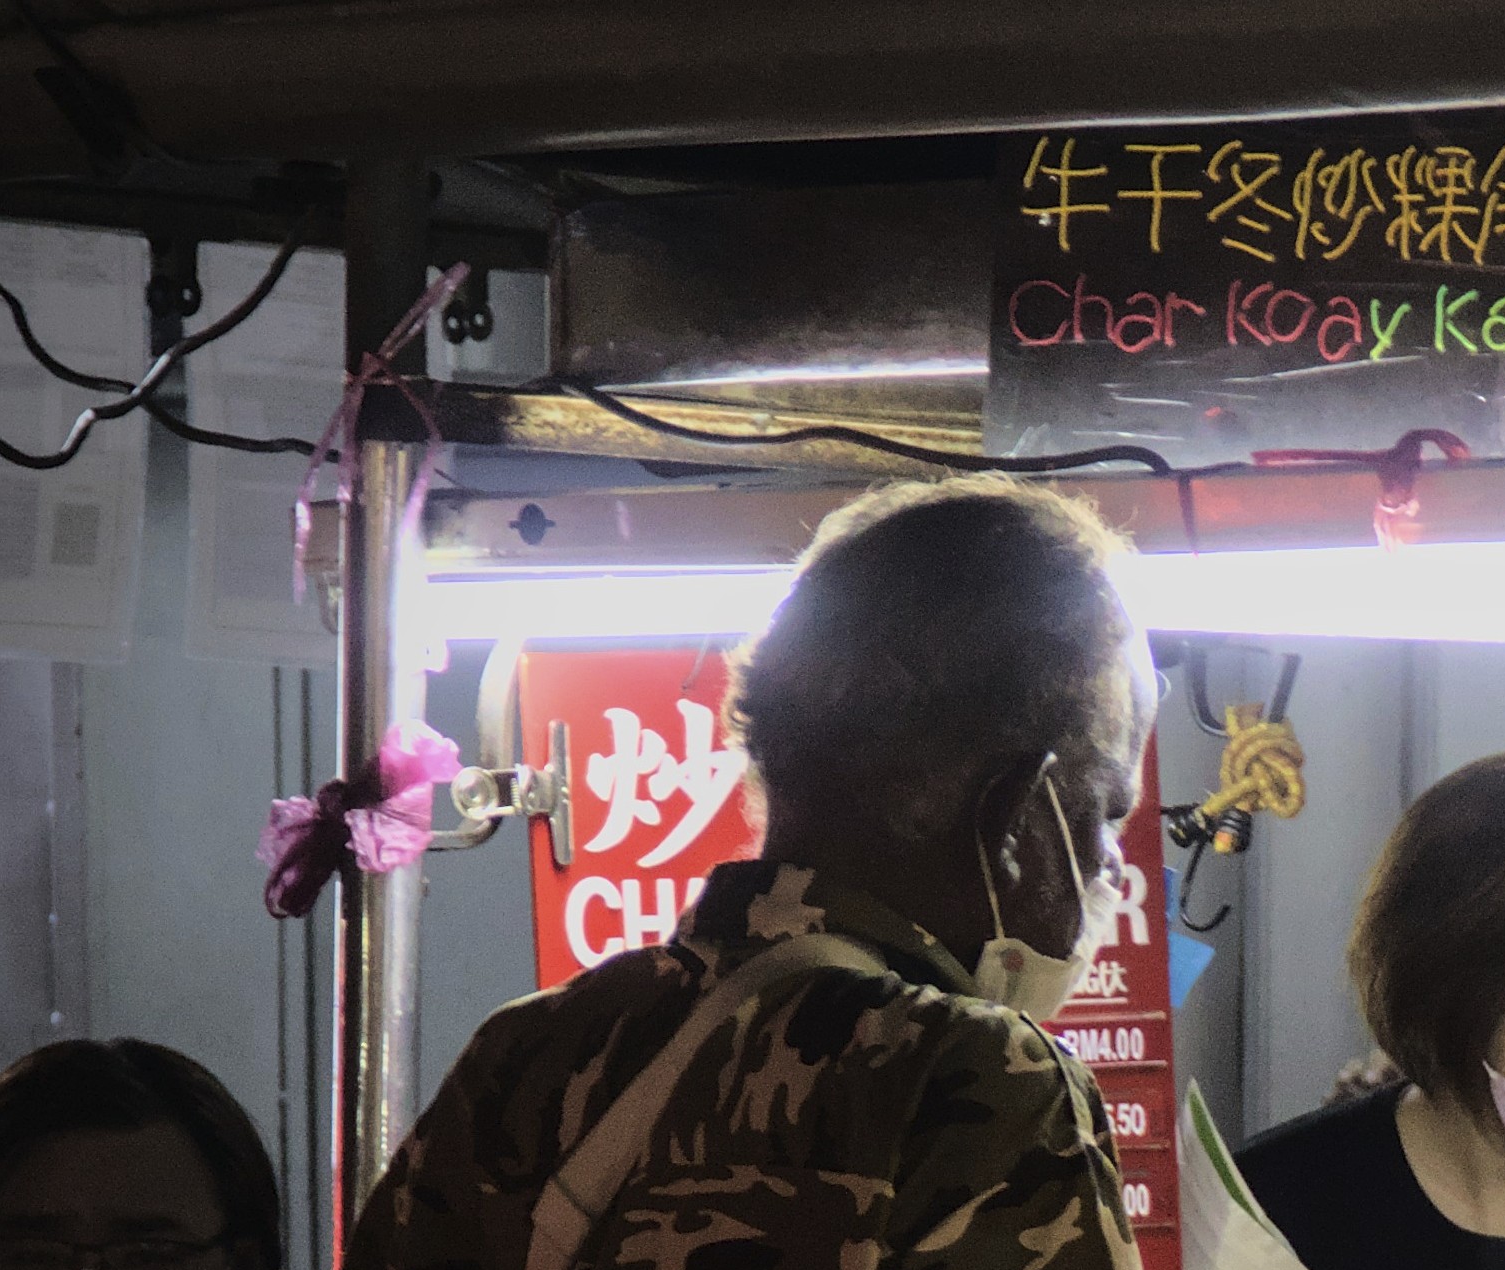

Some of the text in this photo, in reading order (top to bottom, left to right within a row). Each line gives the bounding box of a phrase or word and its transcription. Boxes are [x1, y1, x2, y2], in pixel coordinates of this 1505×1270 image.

[1010, 274, 1206, 354] Char
[1227, 280, 1412, 362] Koay
[565, 876, 706, 968] CH
